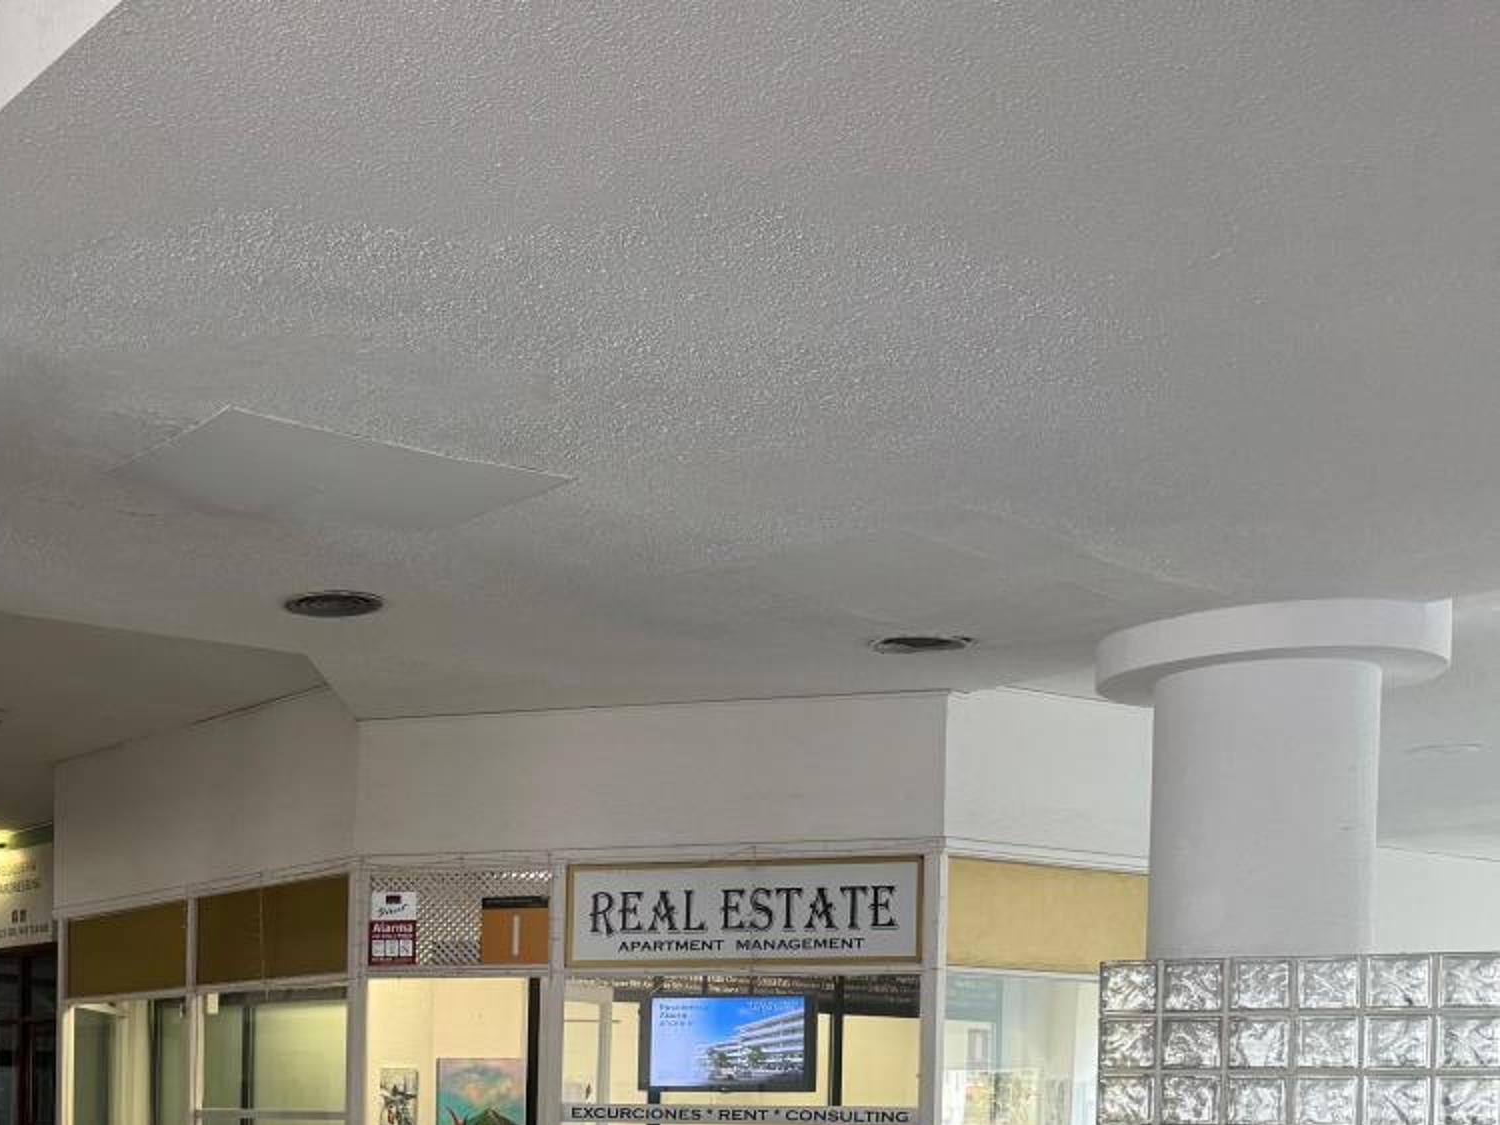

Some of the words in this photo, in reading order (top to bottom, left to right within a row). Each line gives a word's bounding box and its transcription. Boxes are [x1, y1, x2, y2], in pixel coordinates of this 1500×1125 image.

[589, 889, 707, 937] REAL
[720, 884, 899, 931] ESTATE
[373, 923, 413, 933] Alarma
[617, 939, 725, 953] APARTMENT
[735, 937, 865, 951] MANAGEMENT
[570, 1107, 701, 1121] EXCURCIONES
[718, 1109, 770, 1121] RENT
[785, 1109, 909, 1123] CONSULTING
